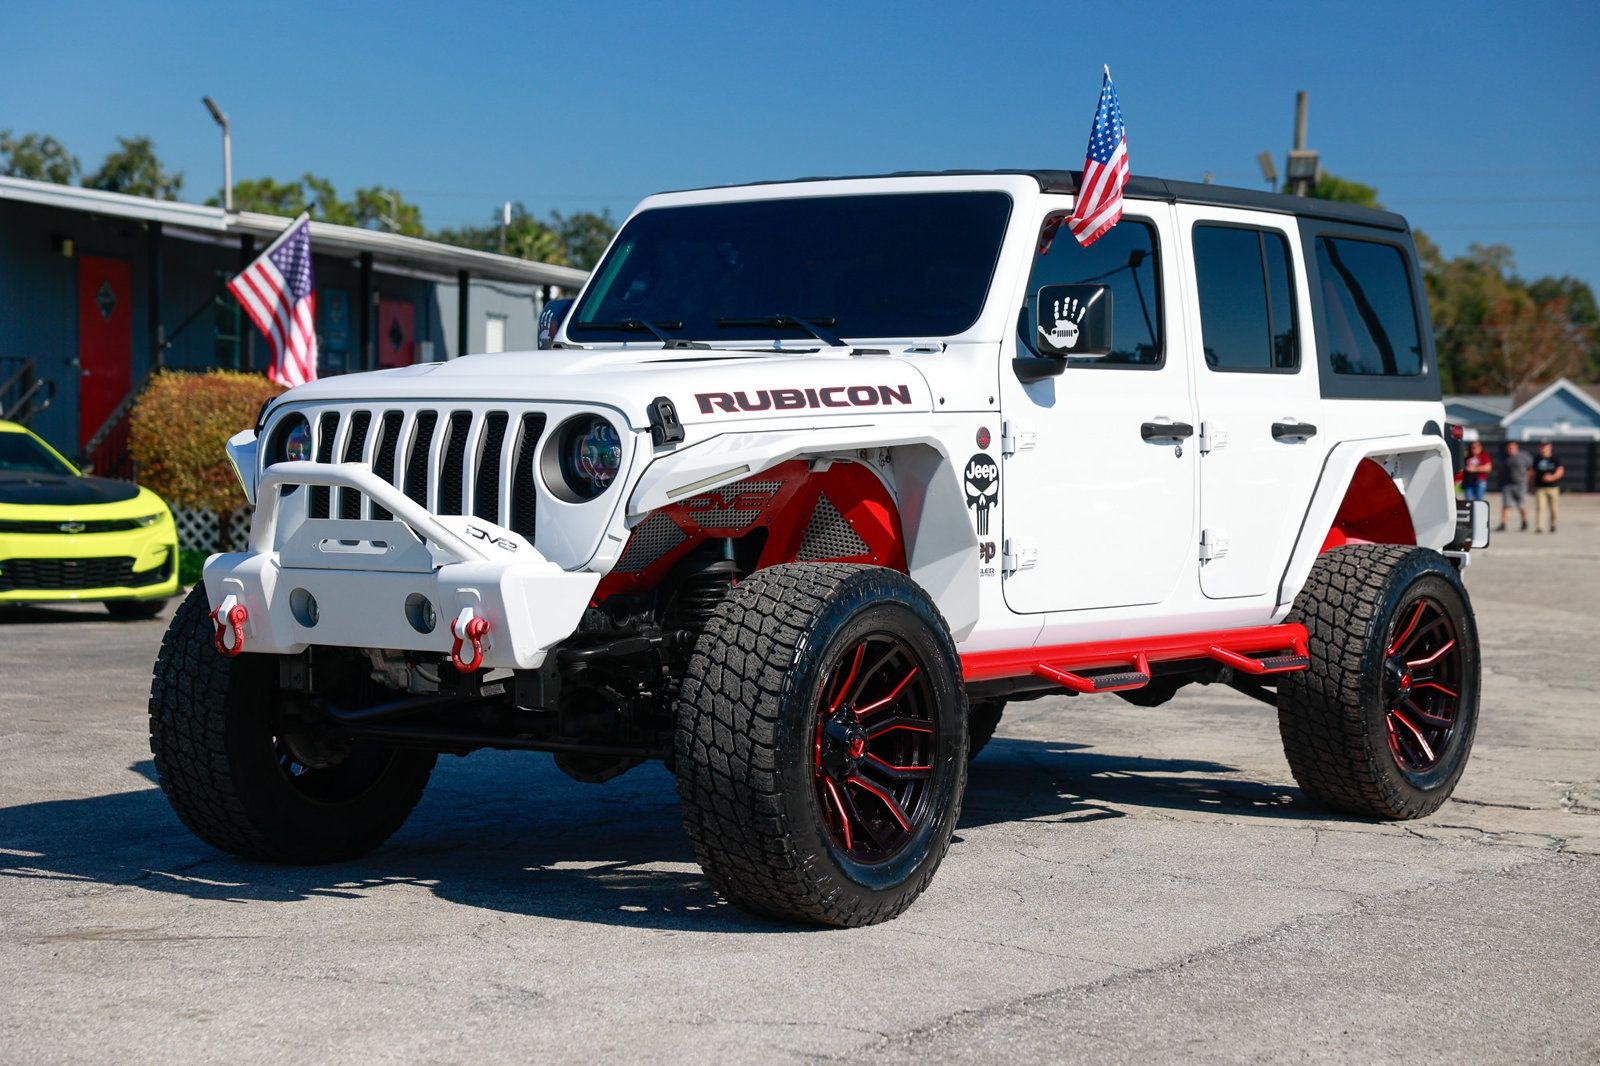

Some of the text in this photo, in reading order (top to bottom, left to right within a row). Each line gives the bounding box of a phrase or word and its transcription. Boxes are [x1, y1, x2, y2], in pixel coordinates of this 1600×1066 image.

[694, 384, 912, 414] RUBICON
[966, 461, 997, 481] Jeep
[980, 541, 996, 564] ep
